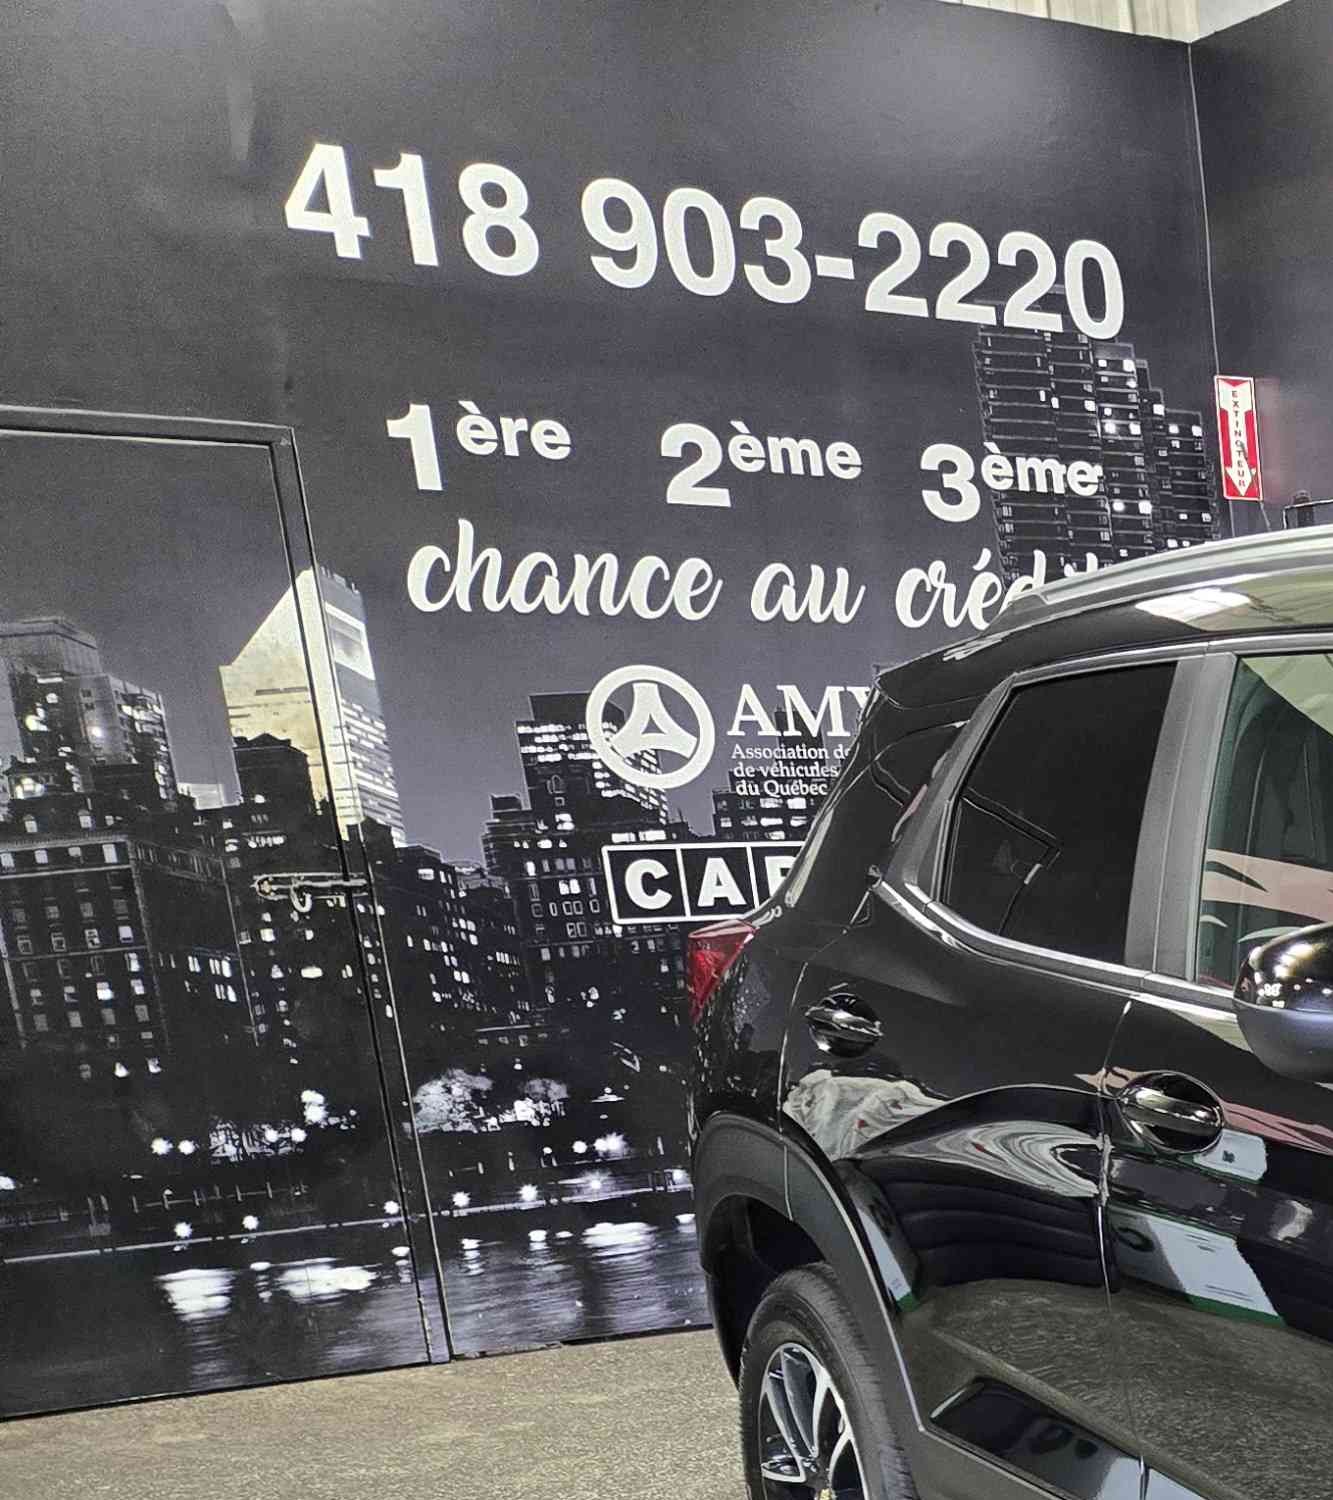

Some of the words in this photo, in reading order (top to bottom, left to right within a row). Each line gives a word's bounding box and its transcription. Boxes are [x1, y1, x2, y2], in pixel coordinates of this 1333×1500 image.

[283, 142, 540, 277] 418
[580, 177, 1125, 340] 903-2220
[386, 400, 572, 491] 1ère
[660, 420, 863, 508] 2ème
[920, 442, 1104, 522] 3ème
[1231, 390, 1246, 487] EXTINCTEUR
[406, 517, 724, 621] chance
[750, 562, 867, 624] au
[731, 743, 830, 760] Association
[733, 762, 754, 778] de
[757, 761, 841, 778] véhicules
[735, 780, 760, 796] du
[763, 777, 828, 798] Québec
